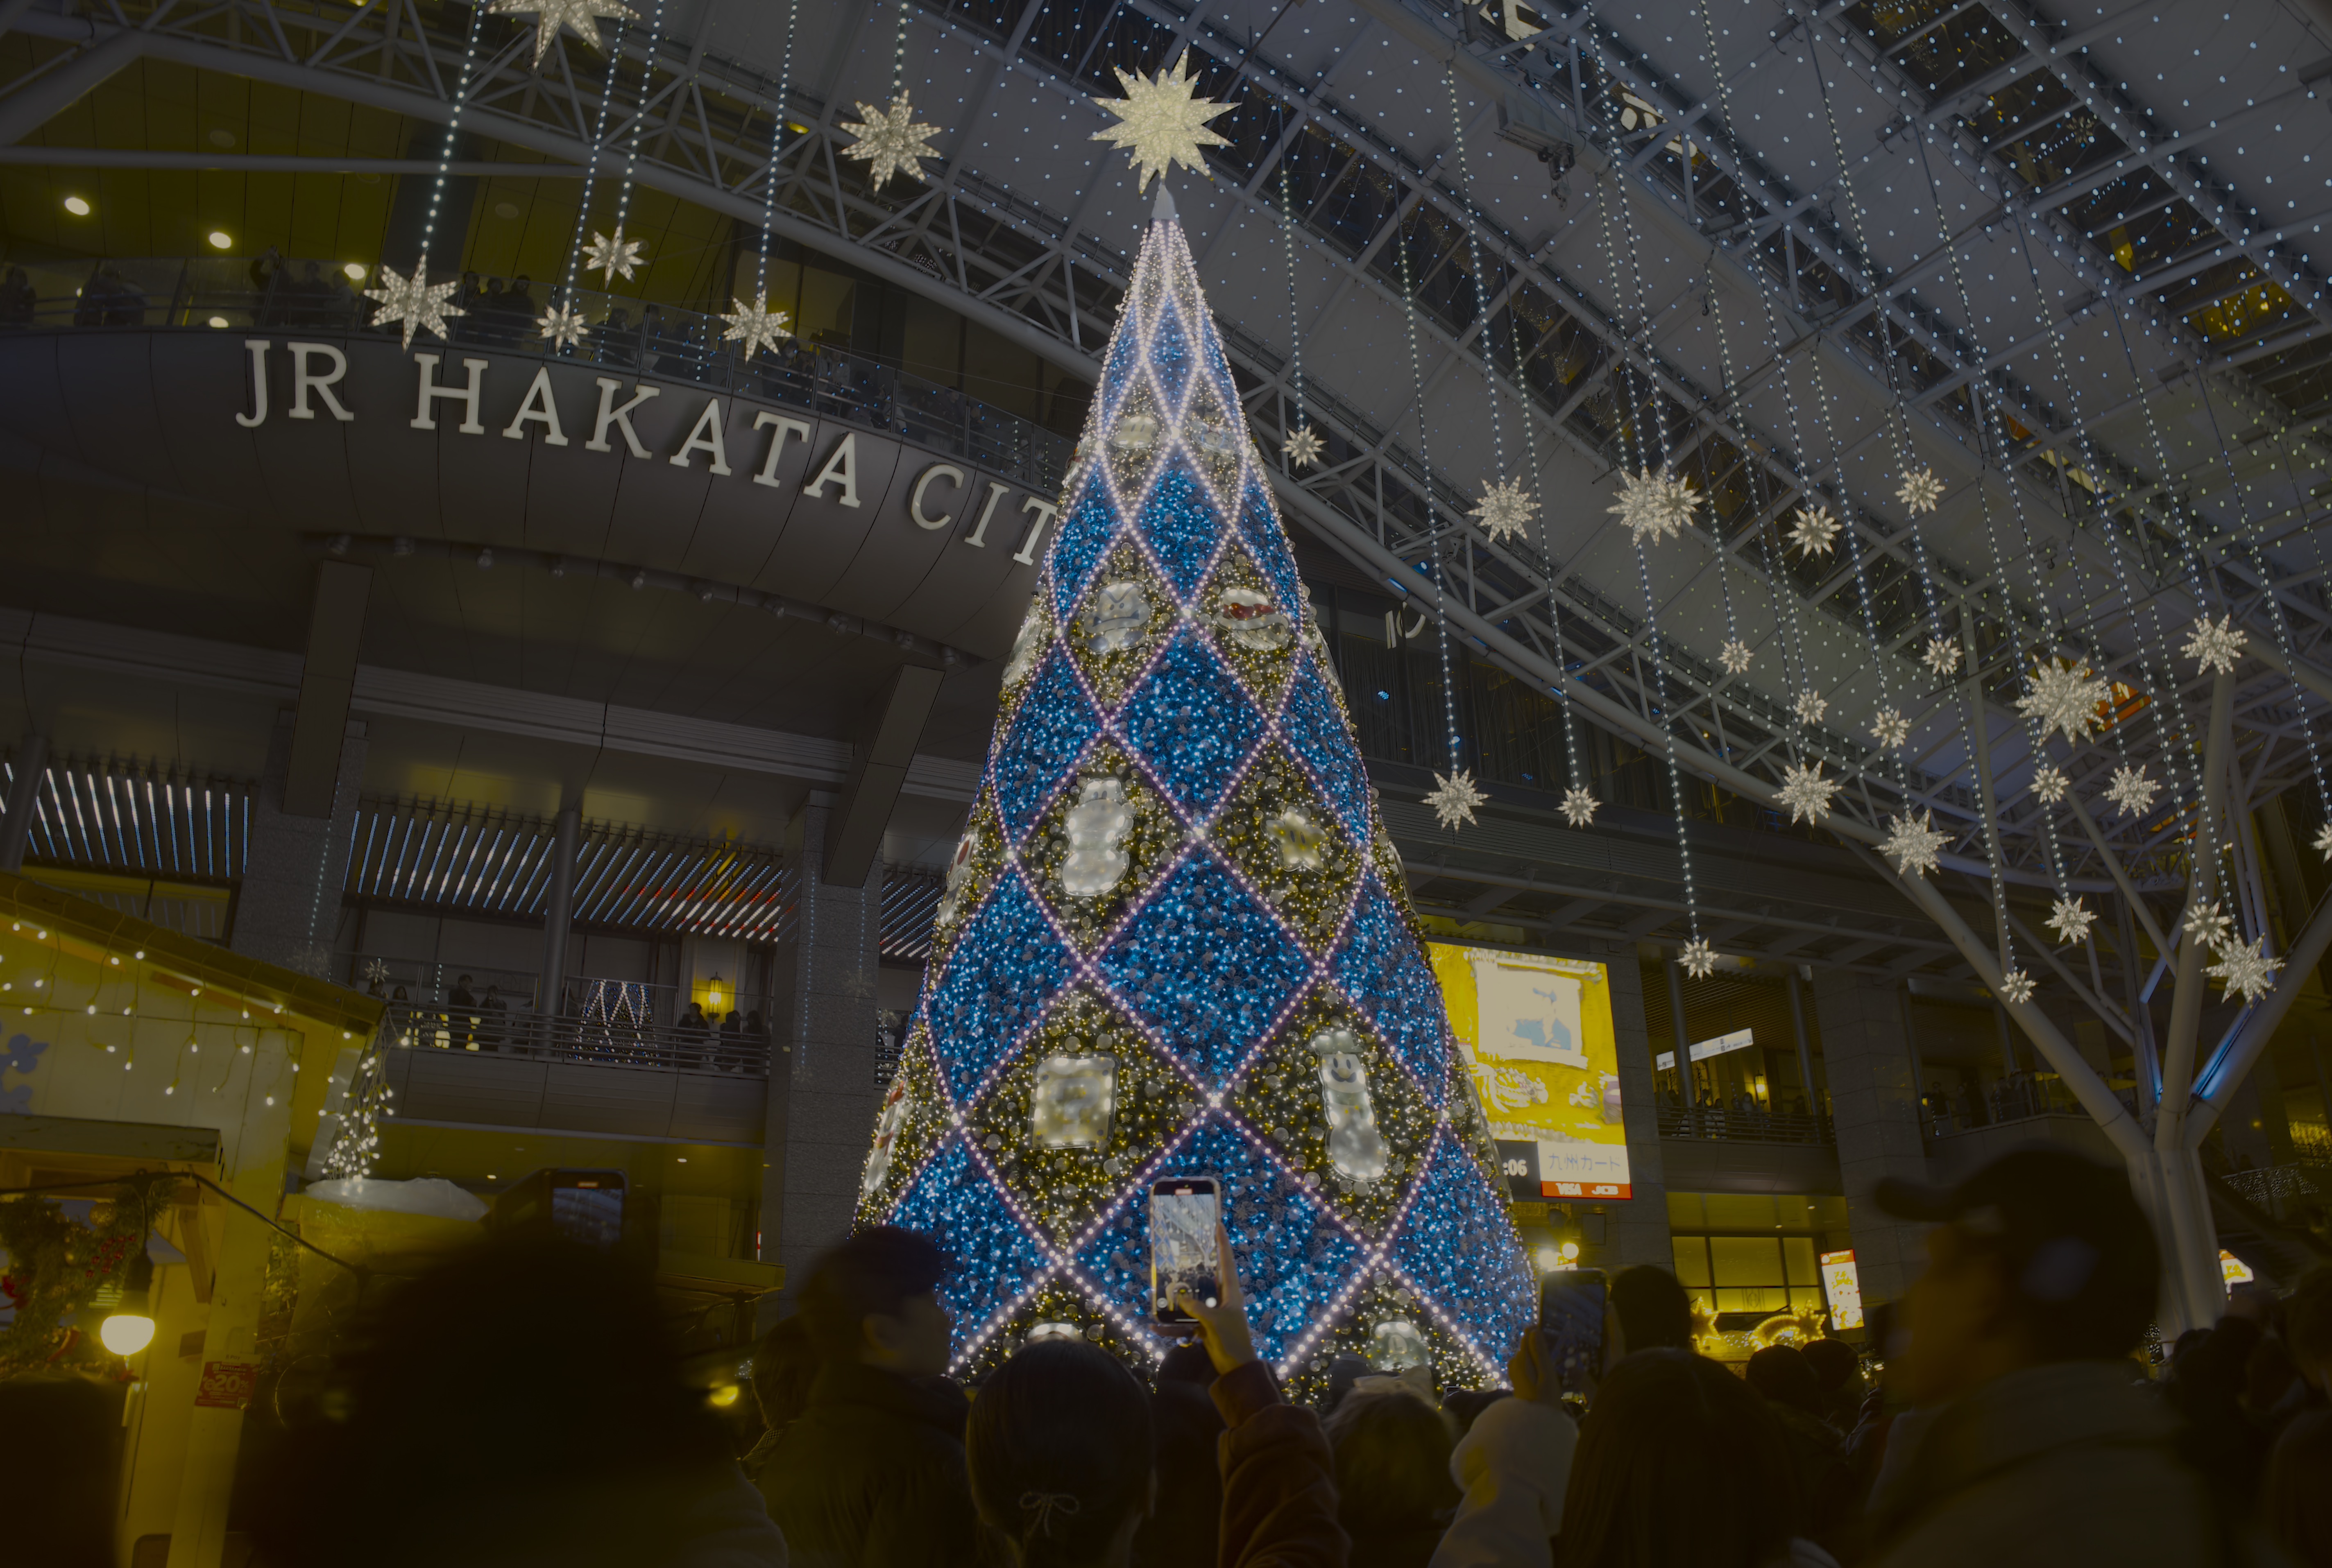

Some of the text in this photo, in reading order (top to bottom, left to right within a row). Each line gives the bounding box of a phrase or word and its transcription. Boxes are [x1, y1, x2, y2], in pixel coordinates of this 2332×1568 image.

[236, 339, 354, 427] JR
[411, 353, 861, 508] HAKATA
[1555, 1183, 1582, 1196] VISA
